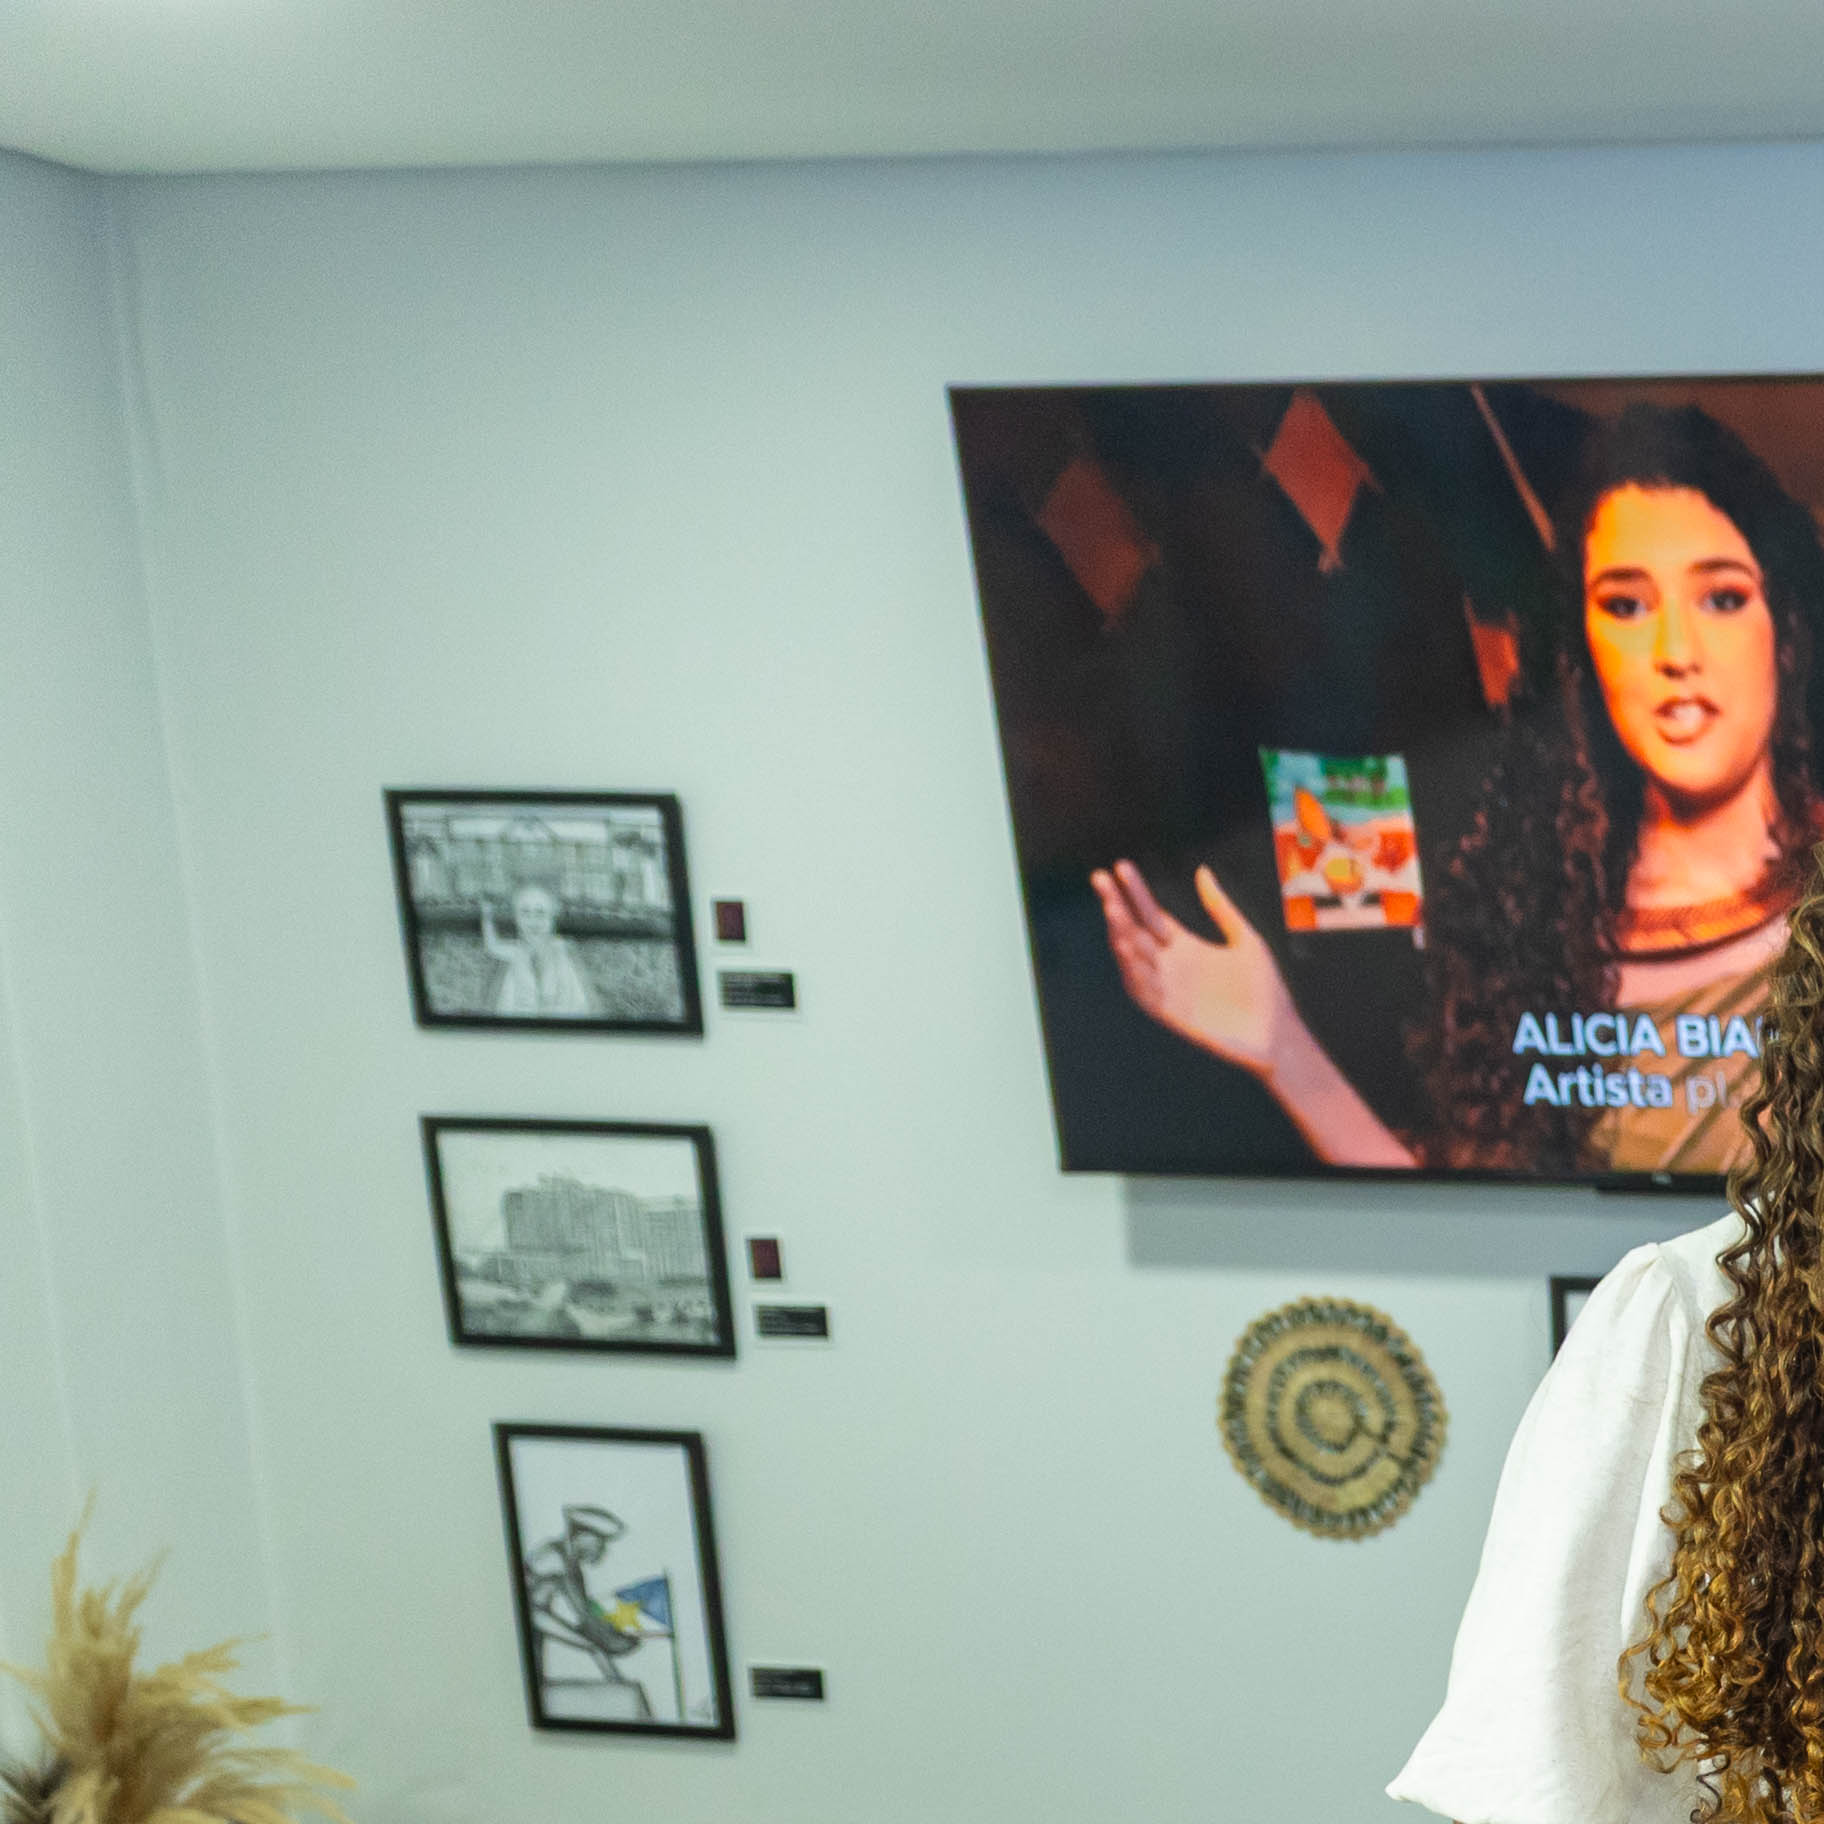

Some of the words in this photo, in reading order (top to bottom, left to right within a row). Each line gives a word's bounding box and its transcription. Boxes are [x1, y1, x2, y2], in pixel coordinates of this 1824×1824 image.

[1512, 1011, 1666, 1056] ALICIA
[1676, 1013, 1763, 1058] BIA
[1523, 1062, 1673, 1108] Artista
